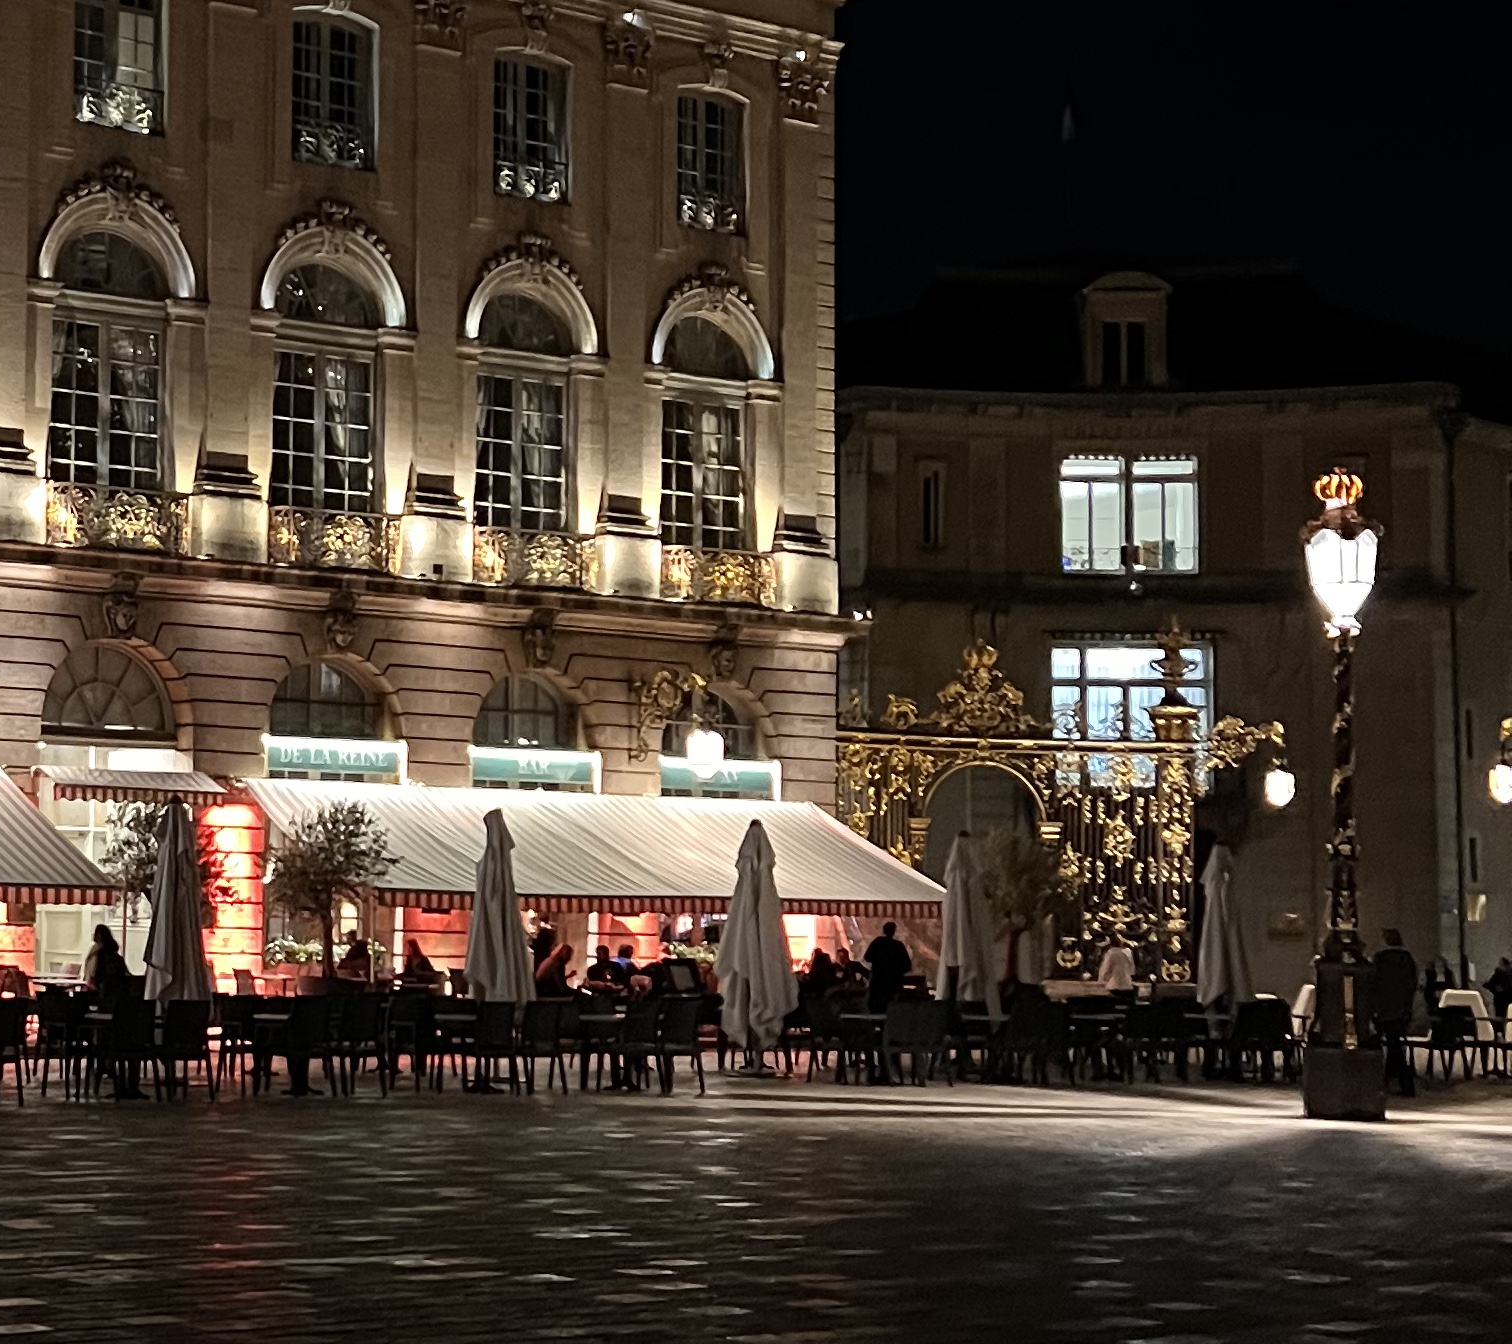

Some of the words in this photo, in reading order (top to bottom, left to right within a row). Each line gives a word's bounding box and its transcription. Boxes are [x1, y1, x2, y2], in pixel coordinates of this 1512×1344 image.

[280, 747, 304, 764] DE
[310, 748, 333, 765] LA
[338, 749, 390, 767] REINE
